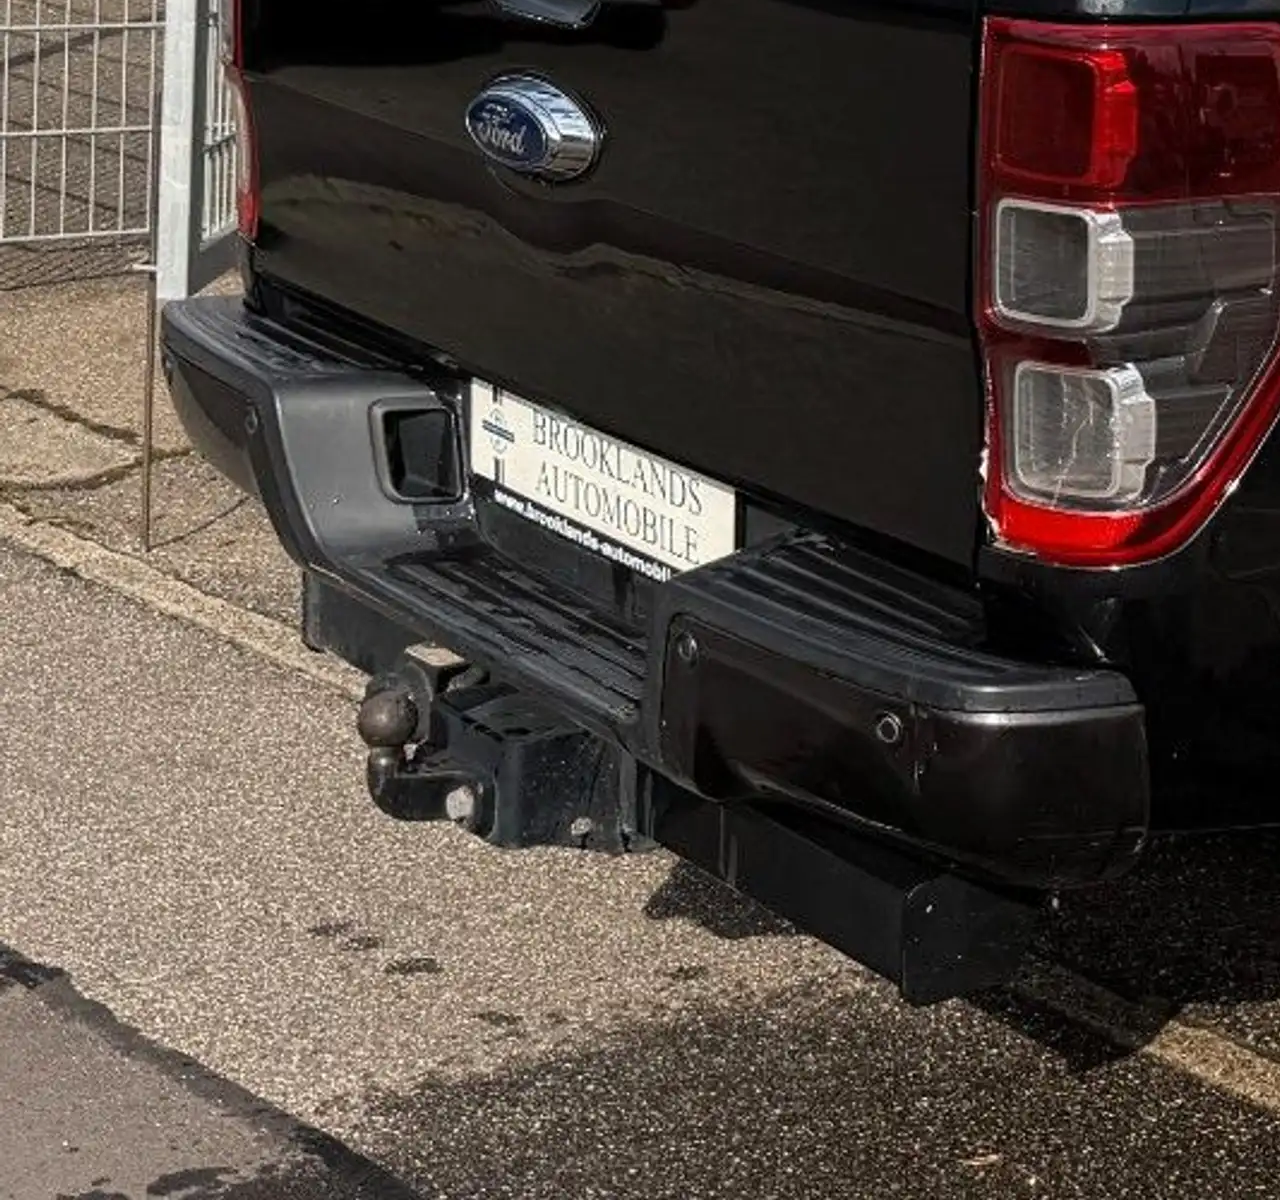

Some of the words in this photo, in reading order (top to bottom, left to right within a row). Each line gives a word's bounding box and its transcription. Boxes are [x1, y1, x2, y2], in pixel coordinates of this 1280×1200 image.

[477, 121, 528, 156] Ford
[532, 407, 704, 517] BROOKLANDS
[535, 461, 700, 565] AUTOMOBILE
